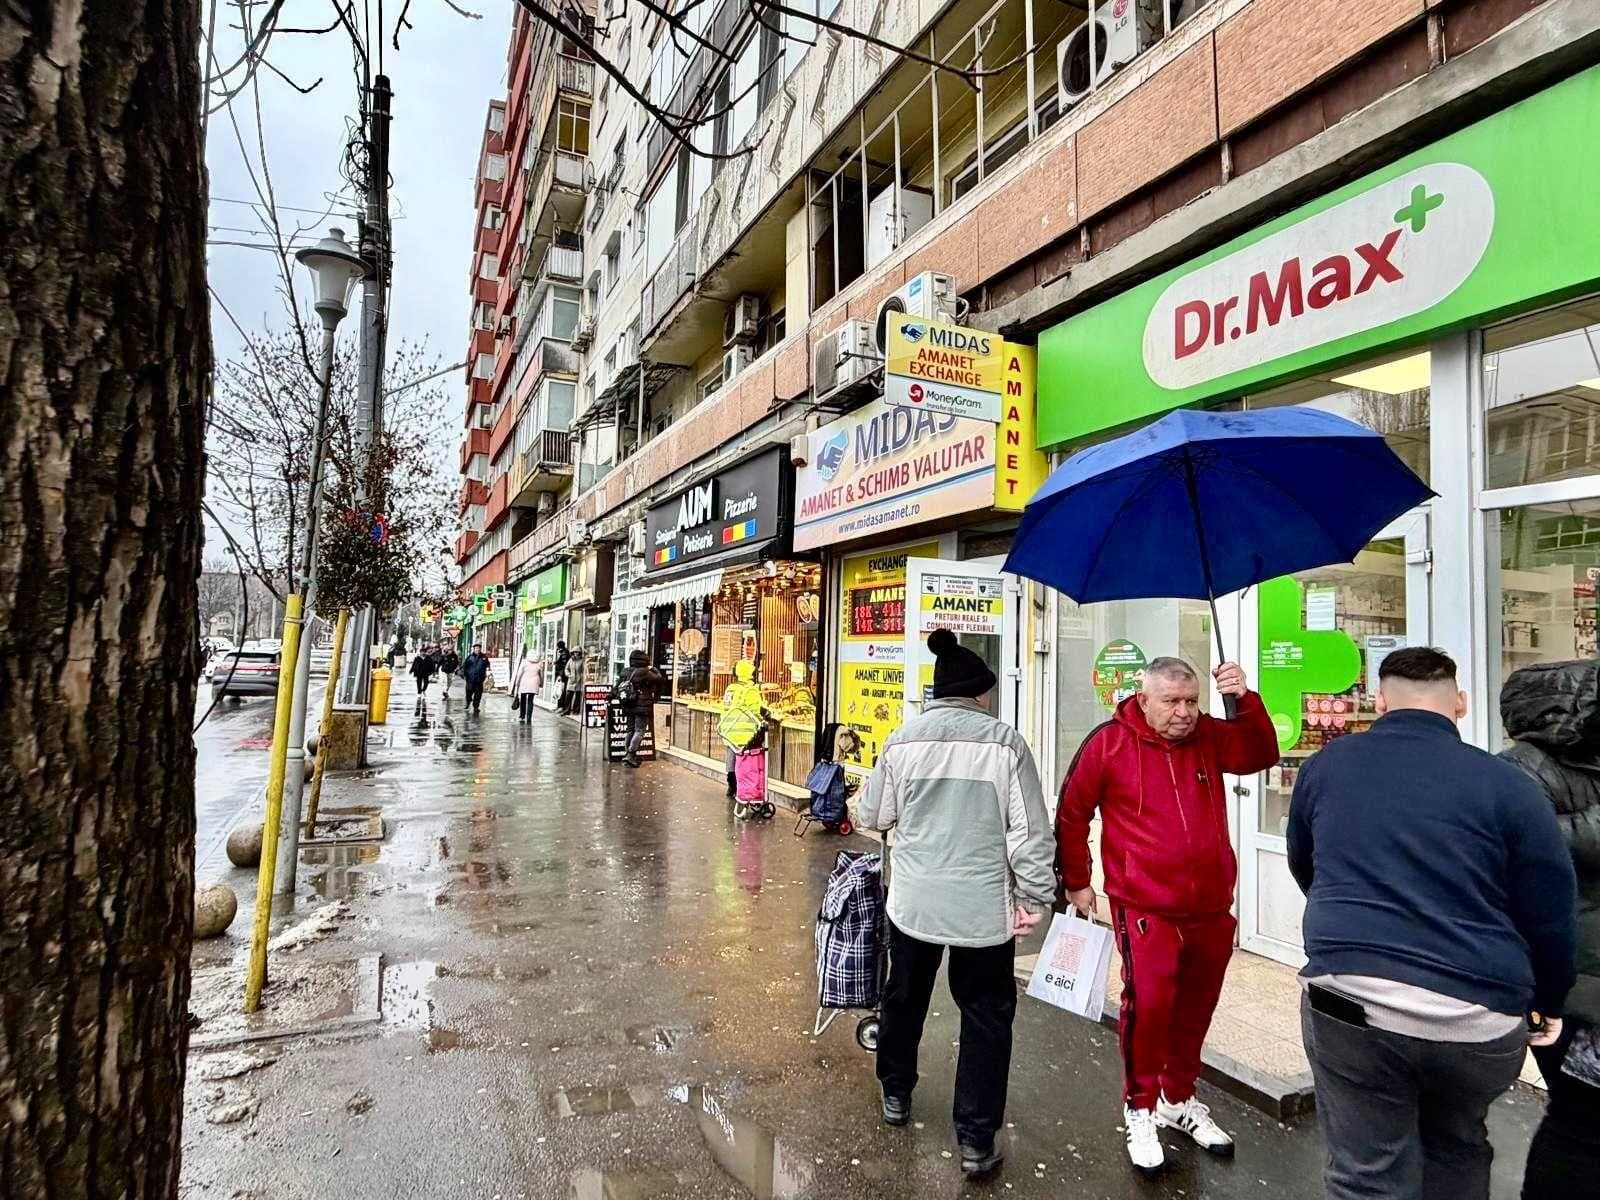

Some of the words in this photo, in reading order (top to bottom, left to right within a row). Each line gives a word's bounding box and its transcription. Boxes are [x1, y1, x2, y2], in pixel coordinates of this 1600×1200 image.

[1174, 228, 1404, 360] Dr.Max
[929, 327, 991, 355] MIDAS
[918, 348, 975, 370] AMANET
[909, 361, 982, 386] EXCHANGE
[926, 390, 982, 409] MoneyGram
[800, 486, 843, 519] AMANET
[846, 484, 854, 502] &
[858, 468, 910, 500] SCHIMB
[913, 435, 985, 482] VALUTAR
[677, 478, 713, 532] AUM
[724, 491, 758, 520] Pizzerie
[838, 503, 920, 534] www.midasamanet.ro
[870, 587, 905, 603] AMANE
[932, 597, 993, 612] AMANET
[855, 605, 872, 619] 18K
[962, 614, 980, 622] REALE
[856, 619, 873, 632] 14K
[855, 669, 880, 682] AMANET
[1045, 973, 1054, 984] e
[1054, 975, 1076, 991] aici
